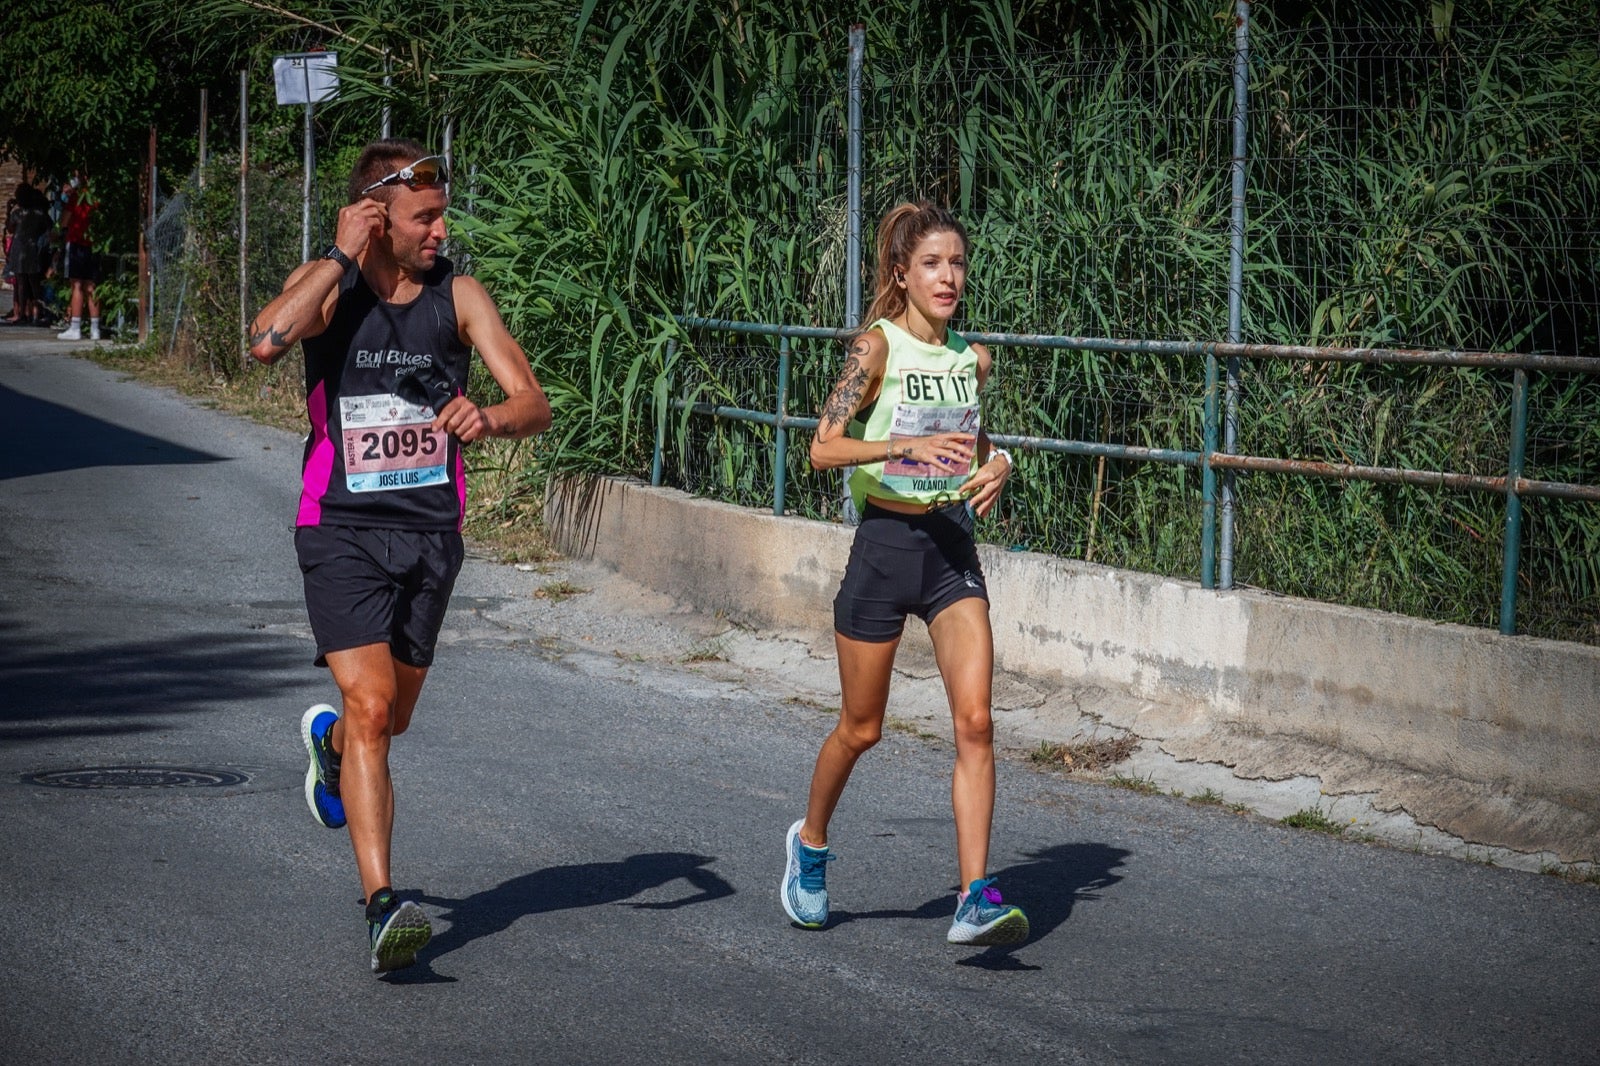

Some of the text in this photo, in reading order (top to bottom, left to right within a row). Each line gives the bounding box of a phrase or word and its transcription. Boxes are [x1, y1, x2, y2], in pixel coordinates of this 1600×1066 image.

[356, 350, 432, 365] Bull Bikes
[906, 374, 969, 403] GET IT
[347, 442, 356, 466] MASTER
[361, 428, 438, 461] 2095
[379, 471, 419, 487] JOSÉ LUIS
[912, 479, 947, 492] YOLANDA
